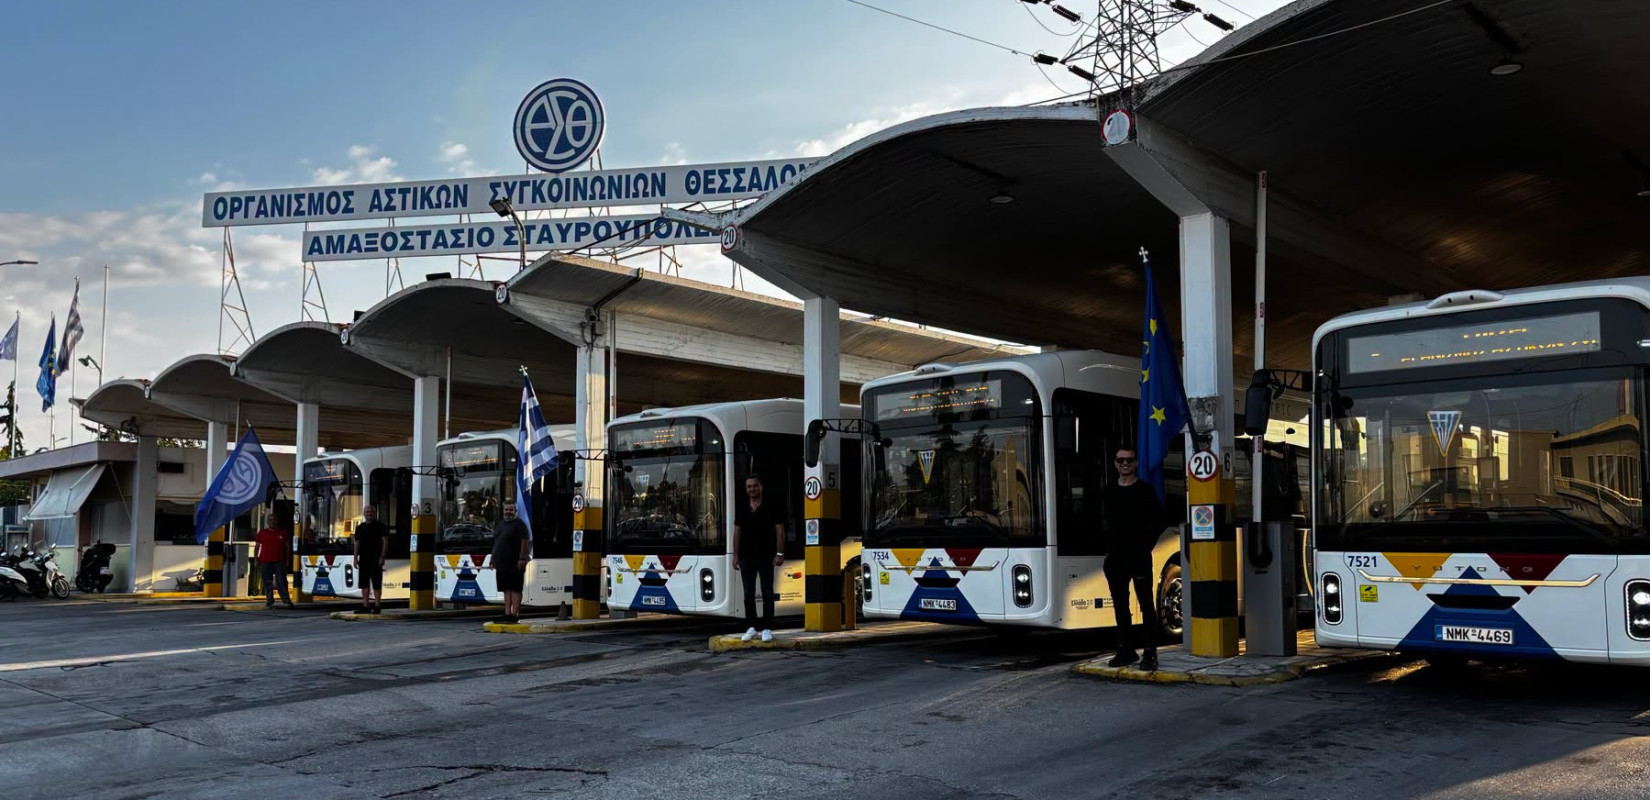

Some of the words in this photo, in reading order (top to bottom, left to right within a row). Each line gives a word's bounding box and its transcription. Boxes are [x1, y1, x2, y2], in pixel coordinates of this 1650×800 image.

[213, 190, 355, 220] ΟΡΓΑΝΙΣΜΟΣ
[368, 183, 468, 213] ΑΣΤΙΚΩΝ
[489, 172, 667, 205] ΣΥΓΚΟΙΝΩΝΙΩΝ
[685, 163, 806, 196] ΘΕΣΣΑΛΟ
[307, 226, 494, 256] ΑΜΑΞΟΣΤΑΣΙΟ
[503, 217, 720, 246] ΣΤΑΥΡΟΥΠΟΛ
[724, 229, 734, 245] 20
[1194, 455, 1212, 475] 20
[1224, 453, 1231, 472] 6
[807, 481, 818, 495] 20
[828, 472, 836, 488] 5
[424, 502, 431, 513] 3
[873, 551, 889, 560] 7534
[1348, 556, 1377, 567] 7521
[1411, 565, 1534, 573] YUTONG
